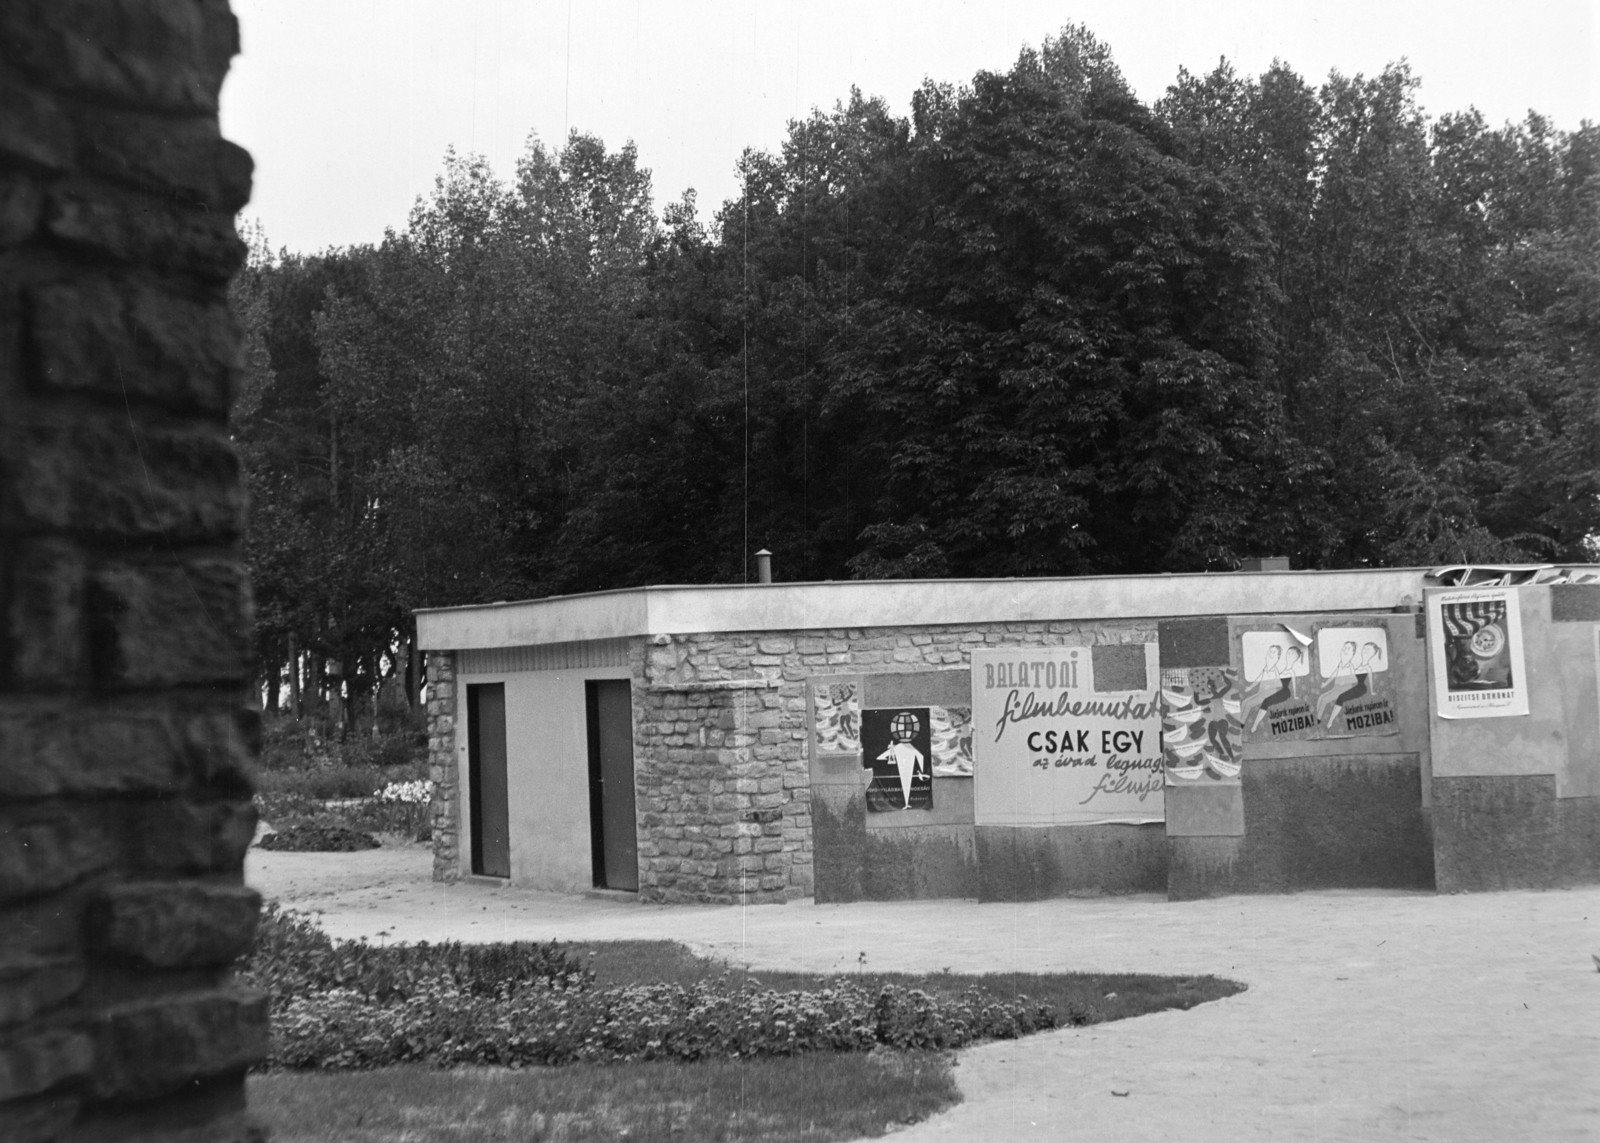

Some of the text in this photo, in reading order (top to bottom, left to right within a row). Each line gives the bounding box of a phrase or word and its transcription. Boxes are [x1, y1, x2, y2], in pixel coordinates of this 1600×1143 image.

[985, 651, 1078, 689] BALATONI
[996, 689, 1162, 742] filmbemutat
[1271, 714, 1315, 735] MOZIBA!
[1346, 710, 1394, 731] MOZIBA!
[1027, 730, 1090, 753] CSAK
[1102, 730, 1143, 754] EGY
[1032, 758, 1050, 770] az
[1055, 754, 1098, 767] évad
[1079, 773, 1164, 805] filmje
